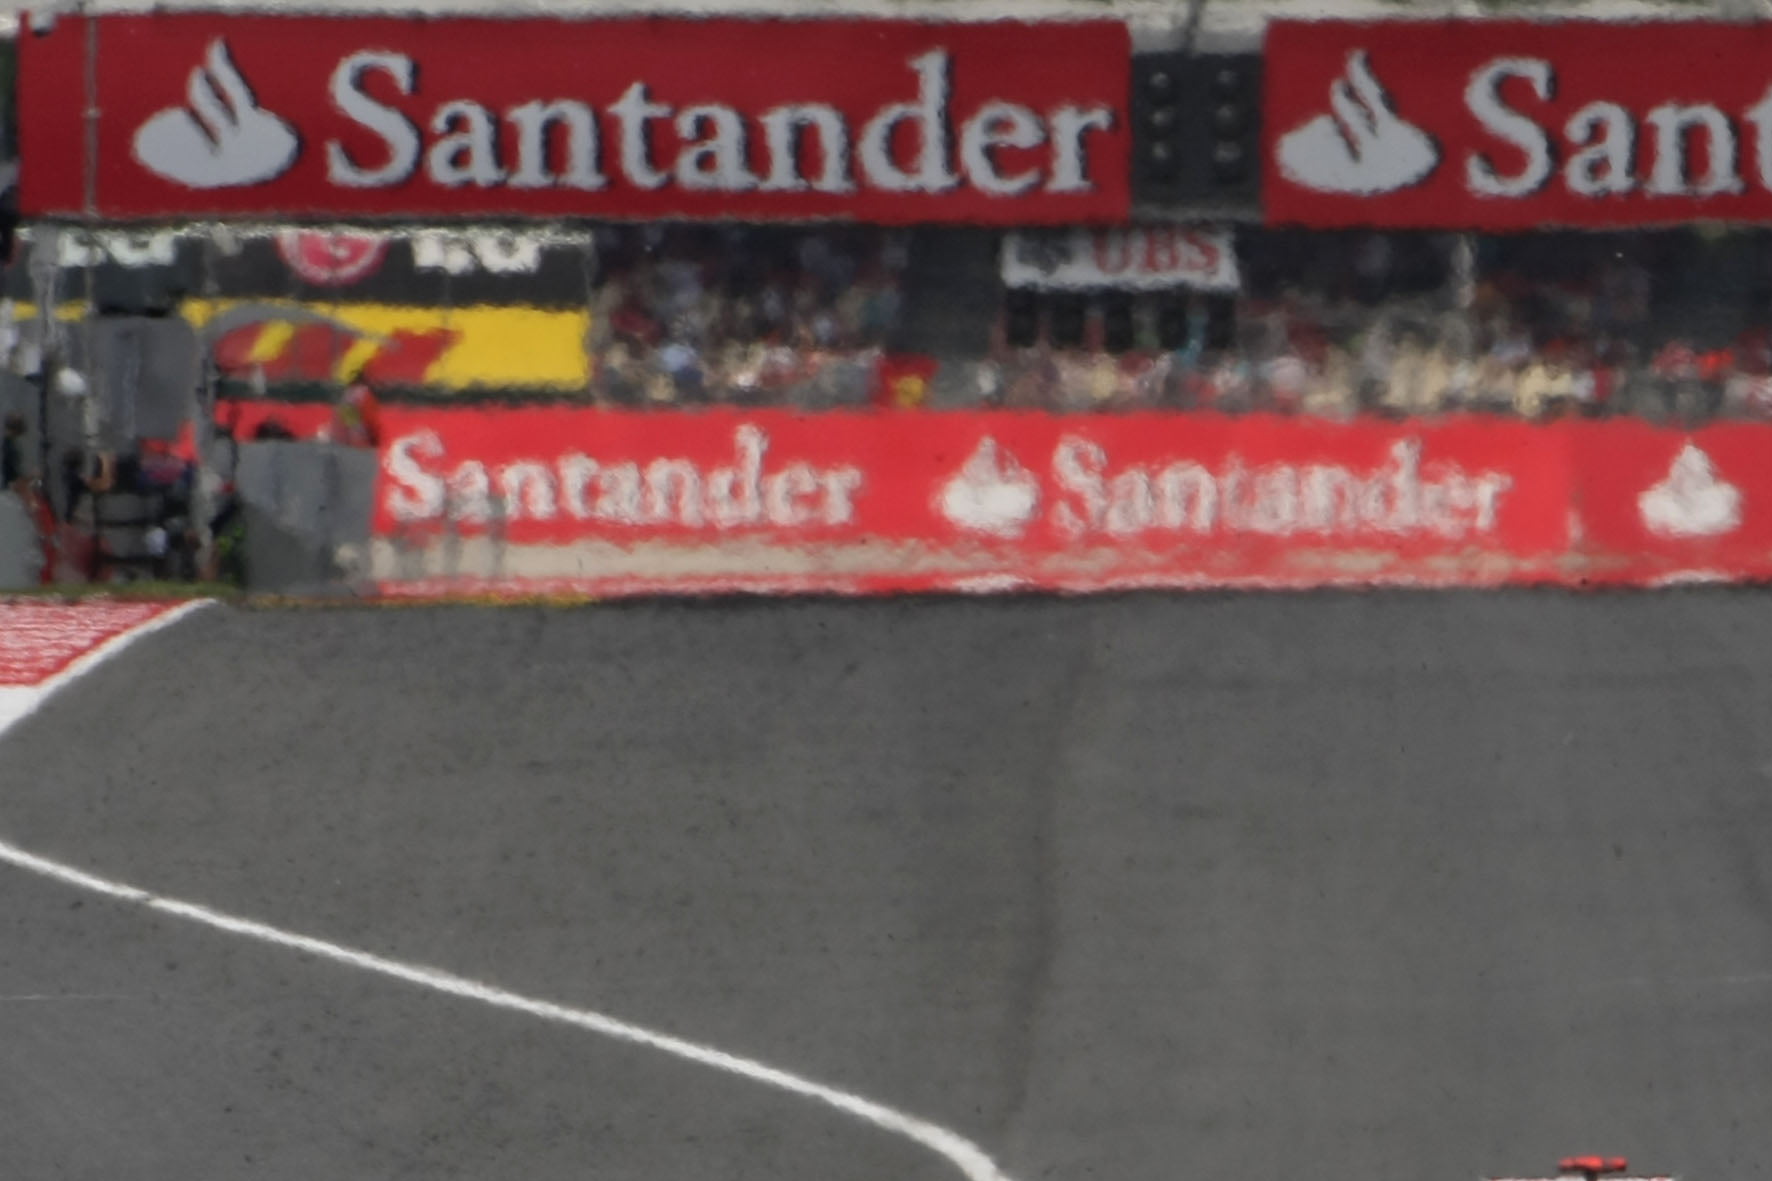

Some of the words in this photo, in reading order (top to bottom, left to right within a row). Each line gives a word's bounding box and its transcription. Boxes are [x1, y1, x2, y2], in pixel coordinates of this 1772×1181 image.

[325, 47, 1115, 197] Santander
[384, 423, 862, 530] Santander
[1051, 436, 1513, 540] Santander
